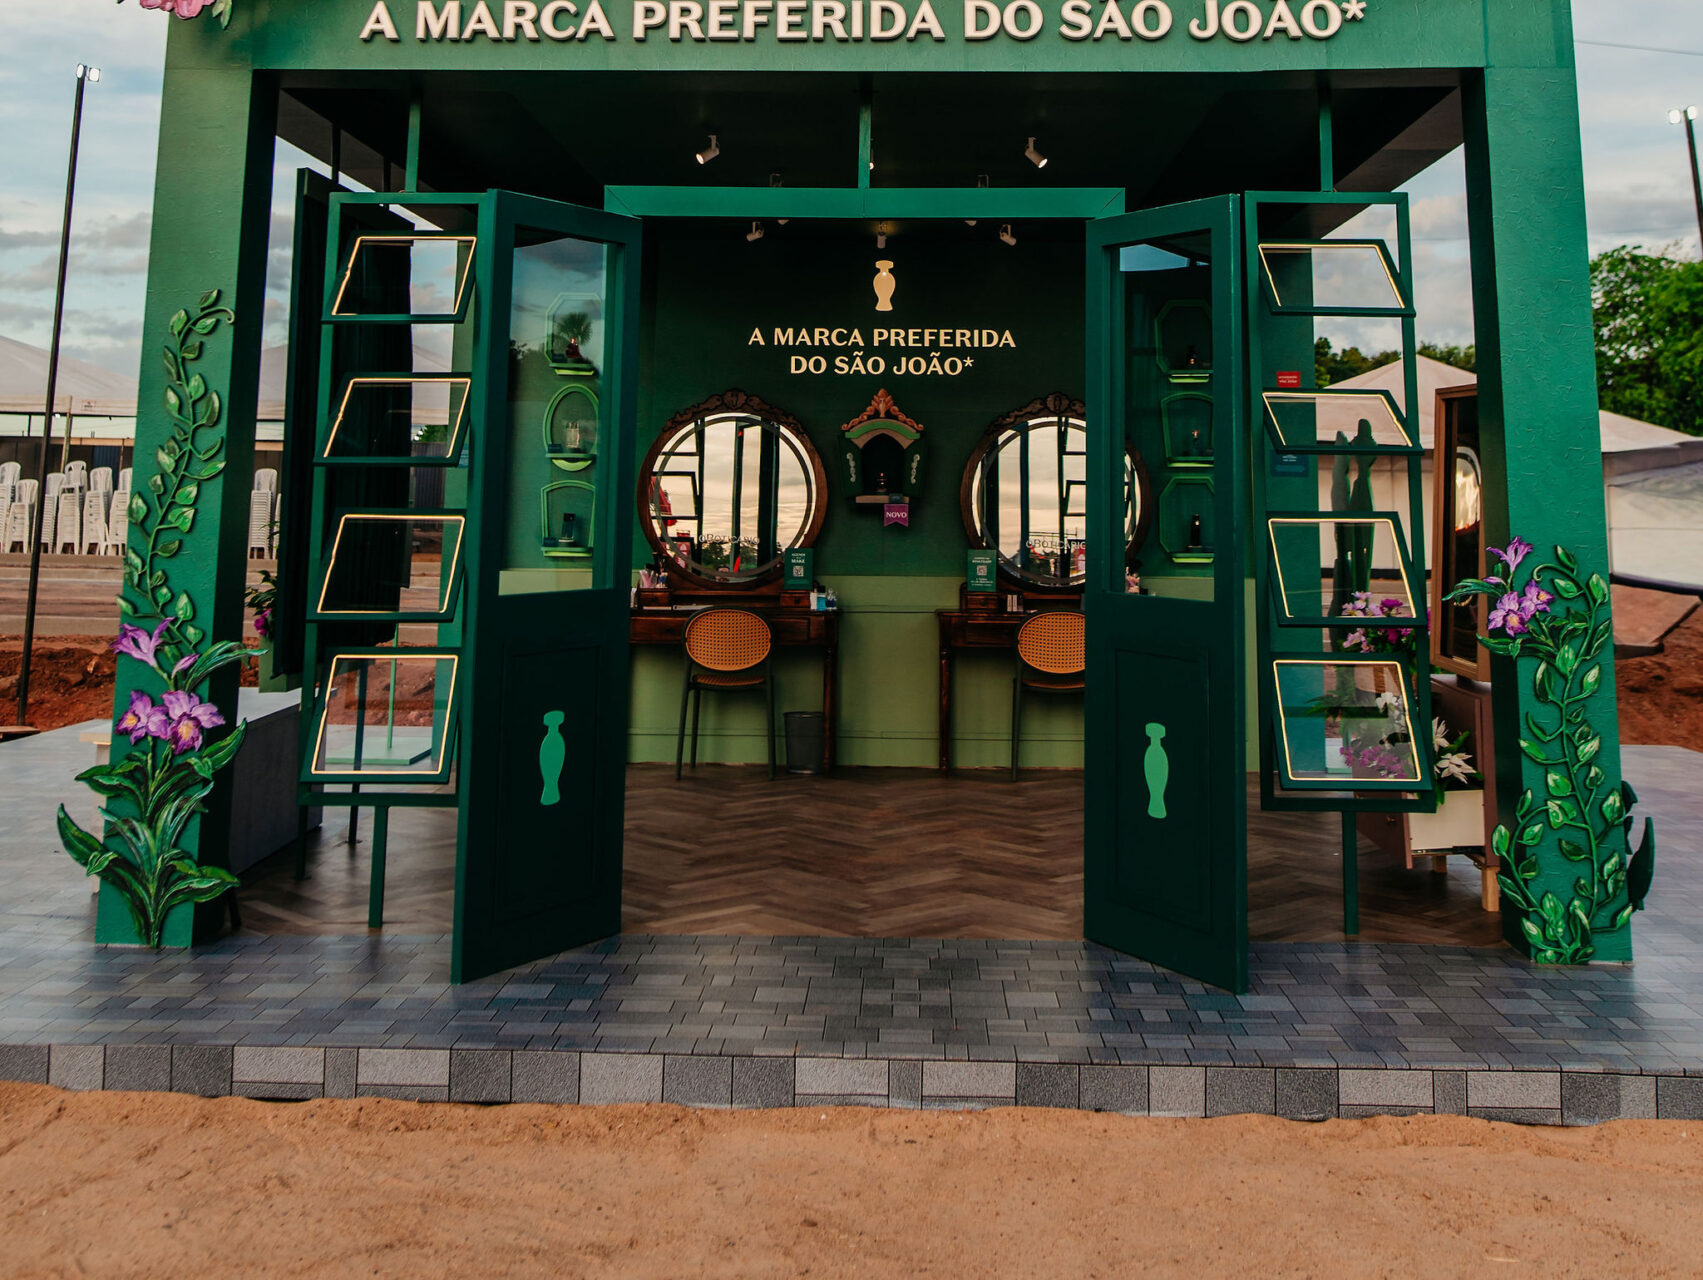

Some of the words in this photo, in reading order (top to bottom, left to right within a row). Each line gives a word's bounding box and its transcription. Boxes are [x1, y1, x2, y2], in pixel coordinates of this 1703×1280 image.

[359, 0, 400, 41] A
[415, 0, 616, 41] MARCA
[632, 0, 946, 41] PREFERIDA
[748, 327, 766, 346] A
[774, 327, 865, 347] MARCA
[873, 328, 1017, 348] PREFERIDA
[790, 355, 827, 375] DO
[833, 350, 886, 375] SÃO
[886, 511, 907, 519] NOVO
